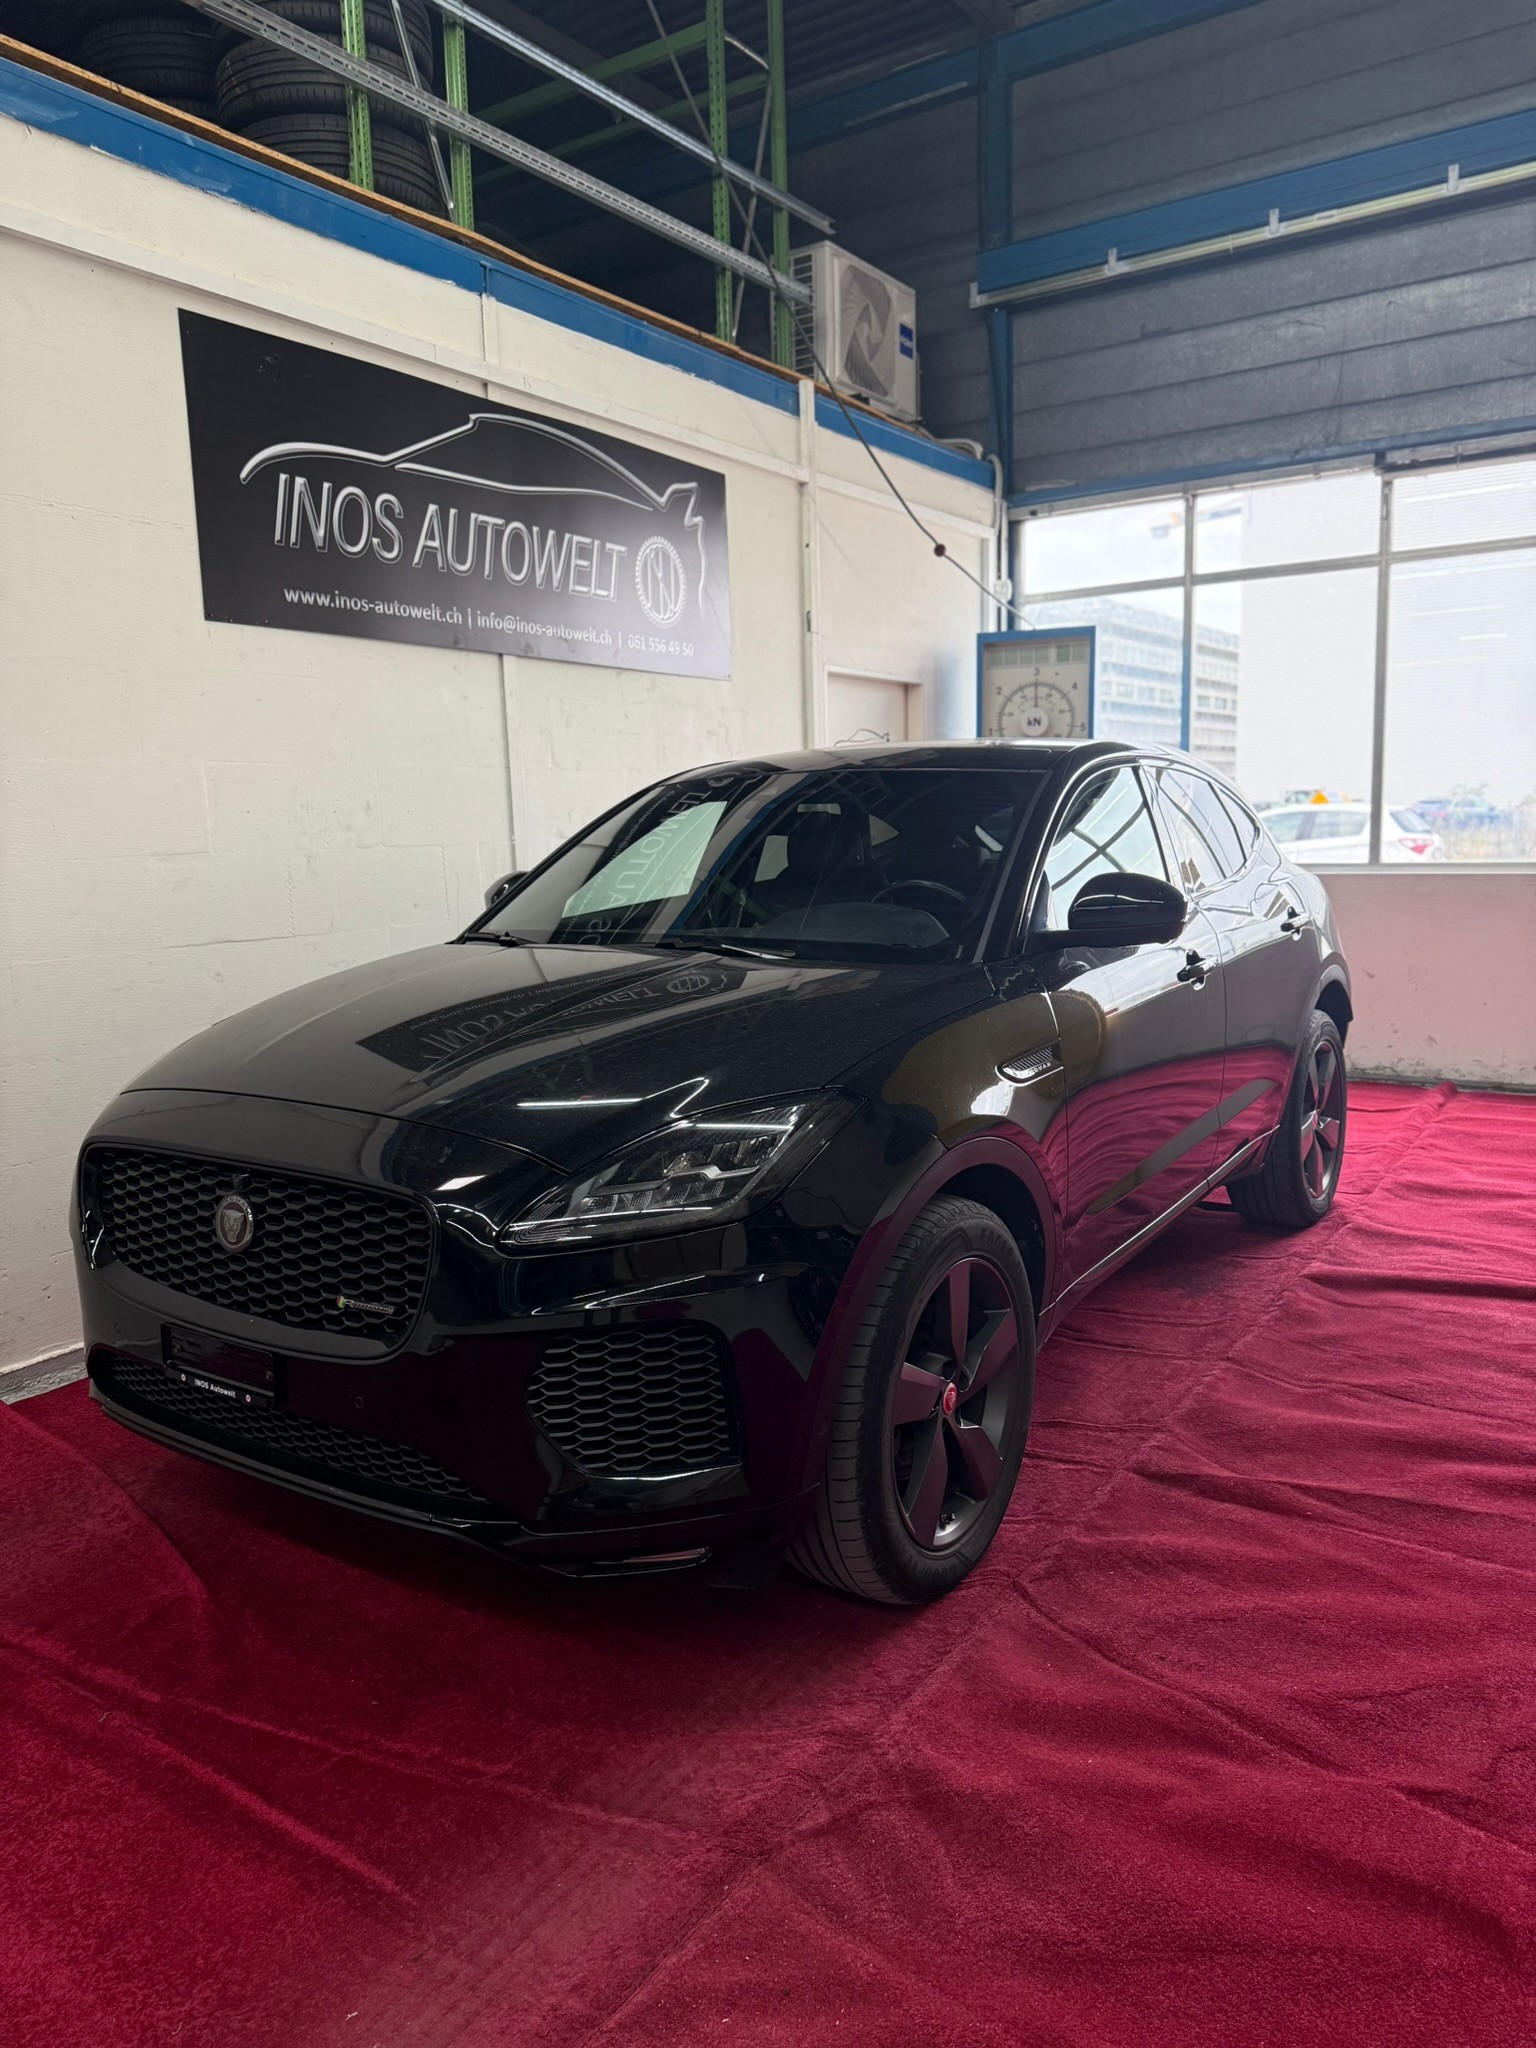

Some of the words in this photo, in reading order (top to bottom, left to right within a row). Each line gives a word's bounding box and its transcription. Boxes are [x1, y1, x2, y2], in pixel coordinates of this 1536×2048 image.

[274, 473, 404, 563] INOS
[412, 504, 628, 601] AUTOWELT
[284, 588, 462, 625] www.inos-autowelt.ch
[477, 611, 612, 646] info@inos-autowelt.ch
[648, 637, 667, 653] 556
[668, 640, 680, 655] 49
[682, 642, 694, 657] 50
[1033, 666, 1040, 676] 3
[995, 685, 1003, 695] 2
[1071, 681, 1079, 690] 4
[1026, 717, 1042, 727] kN
[194, 1378, 209, 1389] INOS
